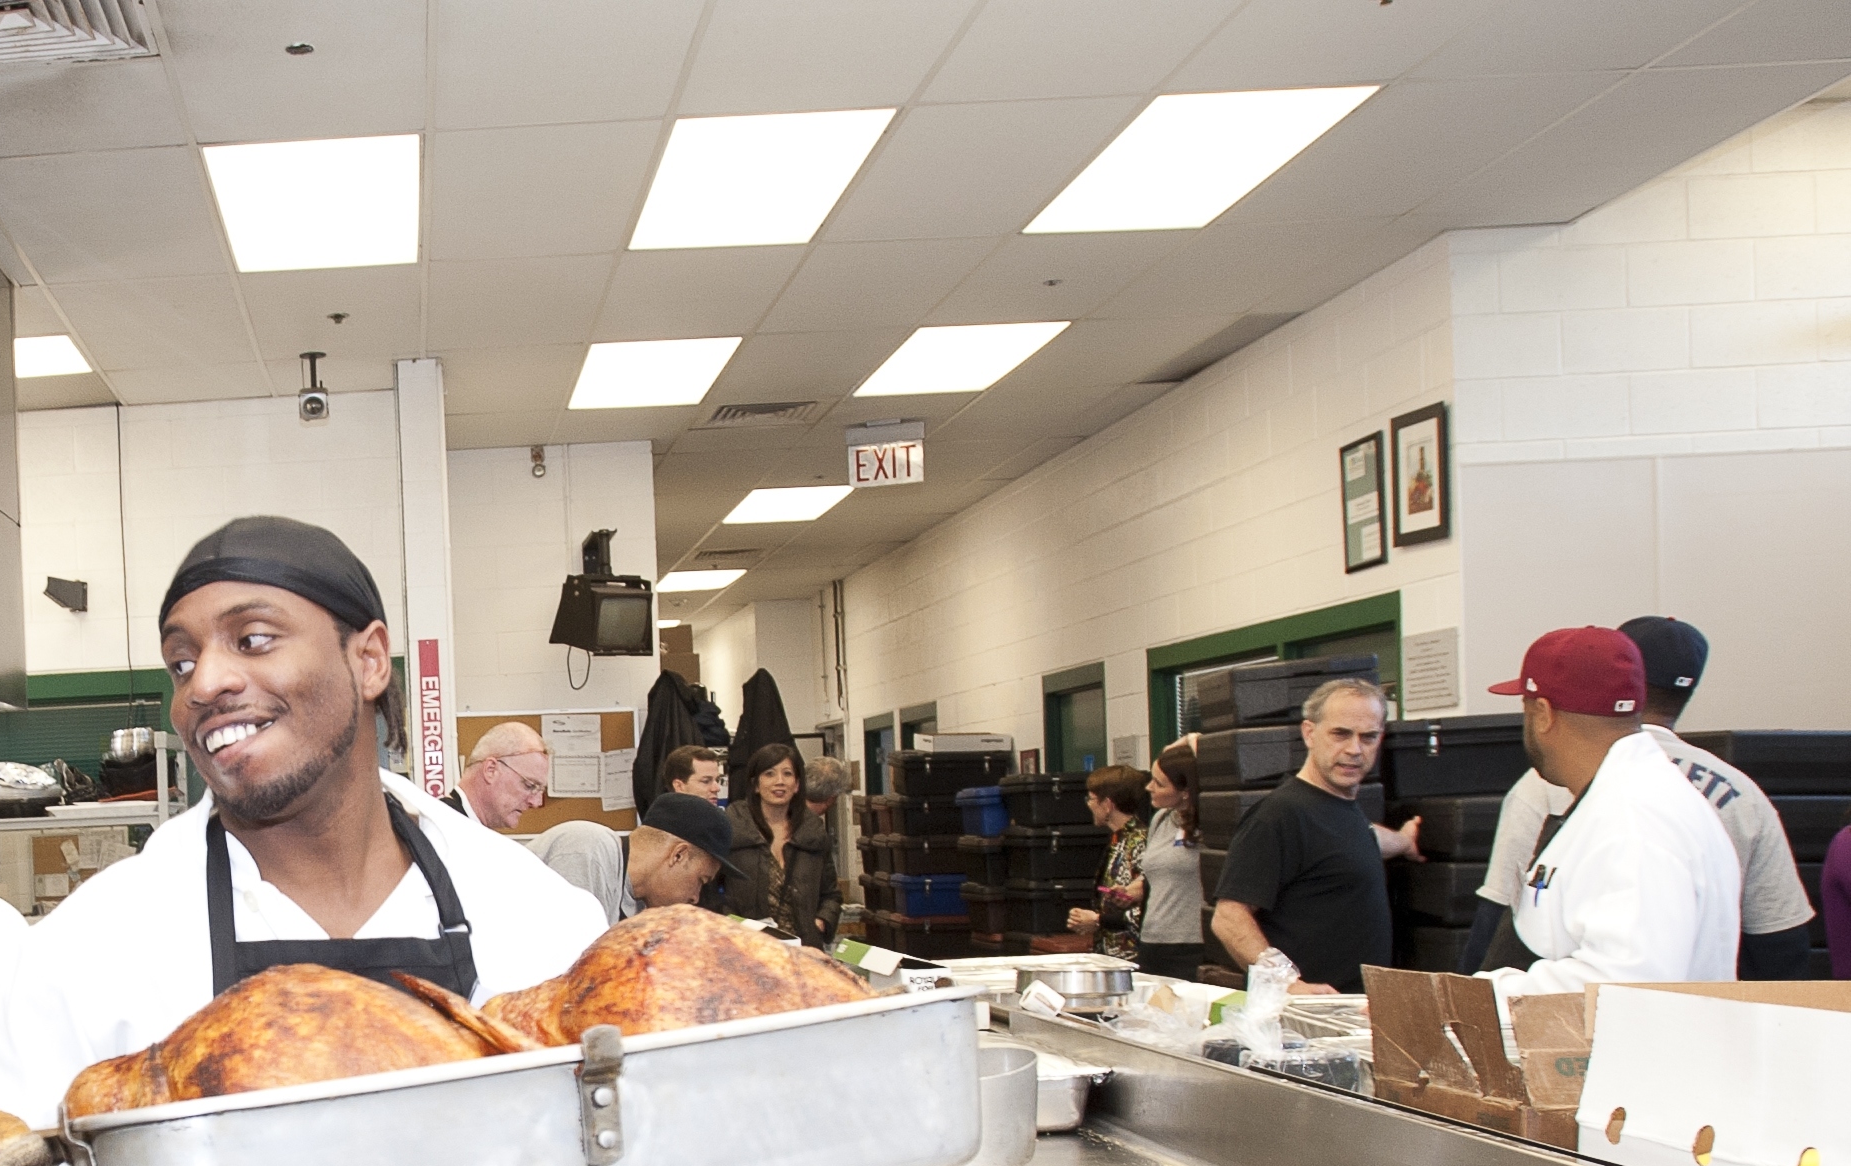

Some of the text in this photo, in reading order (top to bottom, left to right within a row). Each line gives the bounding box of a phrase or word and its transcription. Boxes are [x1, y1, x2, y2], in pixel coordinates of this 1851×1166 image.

[854, 443, 917, 482] EXIT
[421, 676, 445, 800] EMERGENC
[1671, 758, 1741, 810] ETT
